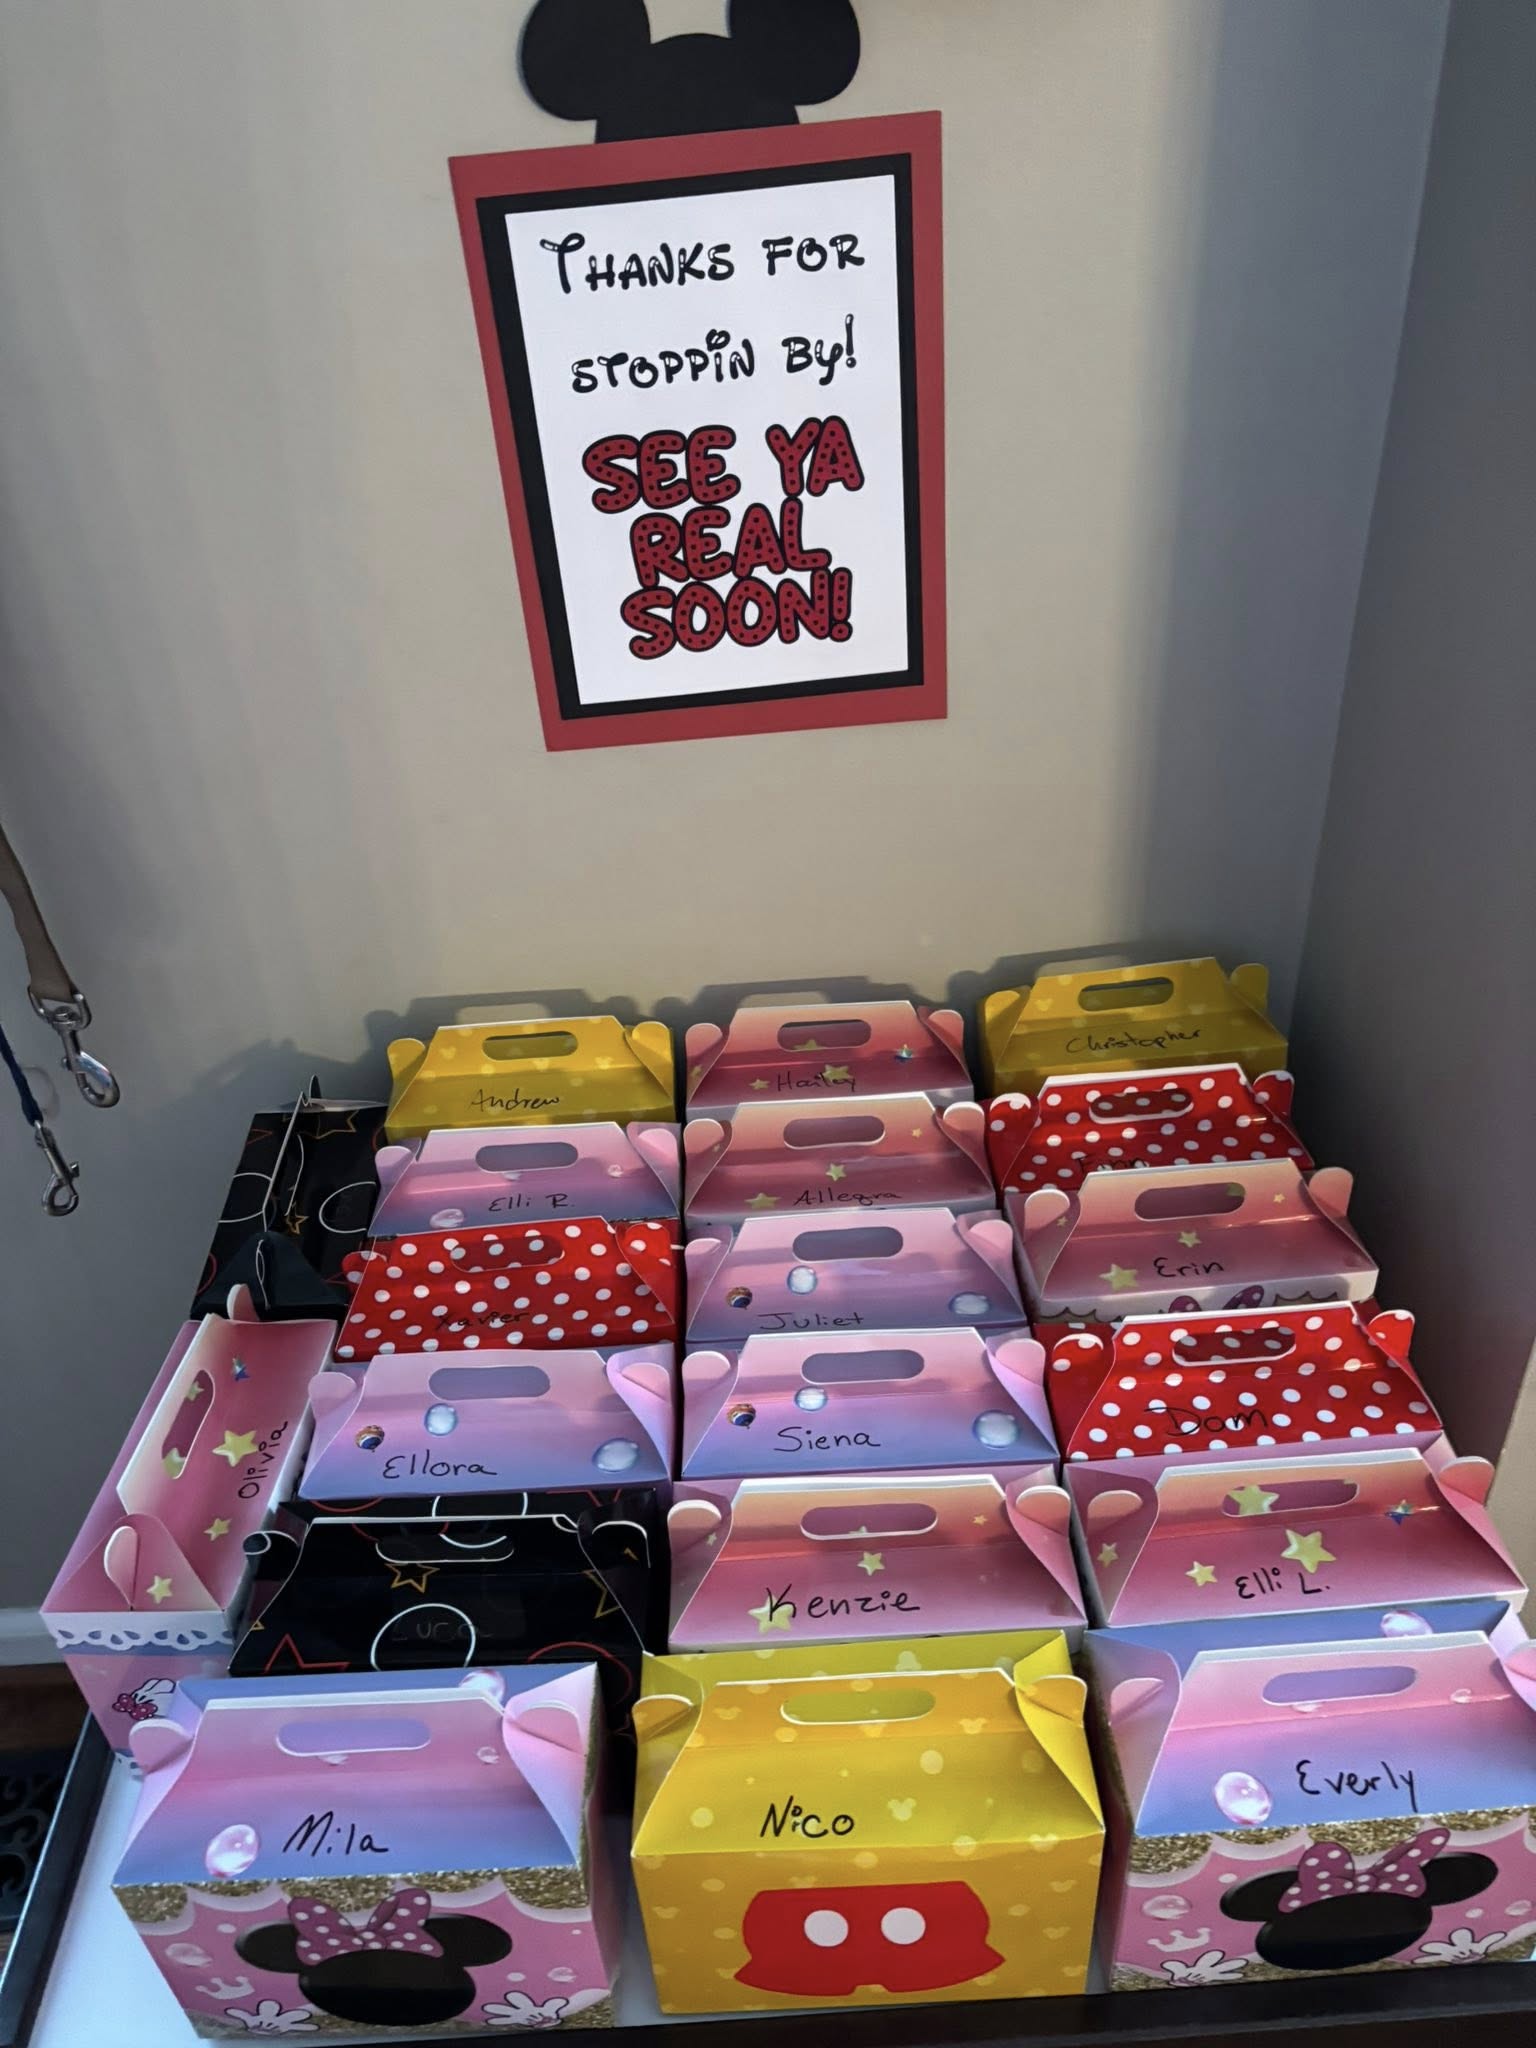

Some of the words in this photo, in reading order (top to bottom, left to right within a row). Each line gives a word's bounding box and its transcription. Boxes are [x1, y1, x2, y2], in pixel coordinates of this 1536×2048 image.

[540, 232, 735, 294] THANKS
[761, 234, 865, 276] FOR
[571, 329, 755, 393] STOPPIN
[582, 424, 741, 514] SEE
[765, 415, 865, 497] YA
[629, 496, 832, 589] REAL
[620, 567, 853, 660] SOON!
[1065, 1029, 1201, 1053] Christopher
[777, 1070, 856, 1093] Hailey
[468, 1087, 560, 1112] Andrew
[793, 1187, 902, 1206] Allegra
[1153, 1257, 1224, 1277] Erin
[757, 1312, 864, 1330] Juliet
[1144, 1406, 1269, 1437] Dom
[773, 1426, 882, 1453] Siena
[237, 1421, 288, 1499] Olivia
[382, 1449, 498, 1479] Ellora
[1235, 1567, 1282, 1599] Elli
[1298, 1572, 1331, 1595] L.
[766, 1583, 921, 1622] Kenzie
[1296, 1759, 1418, 1813] Everly
[282, 1810, 389, 1857] Mila
[759, 1795, 855, 1838] Nico
